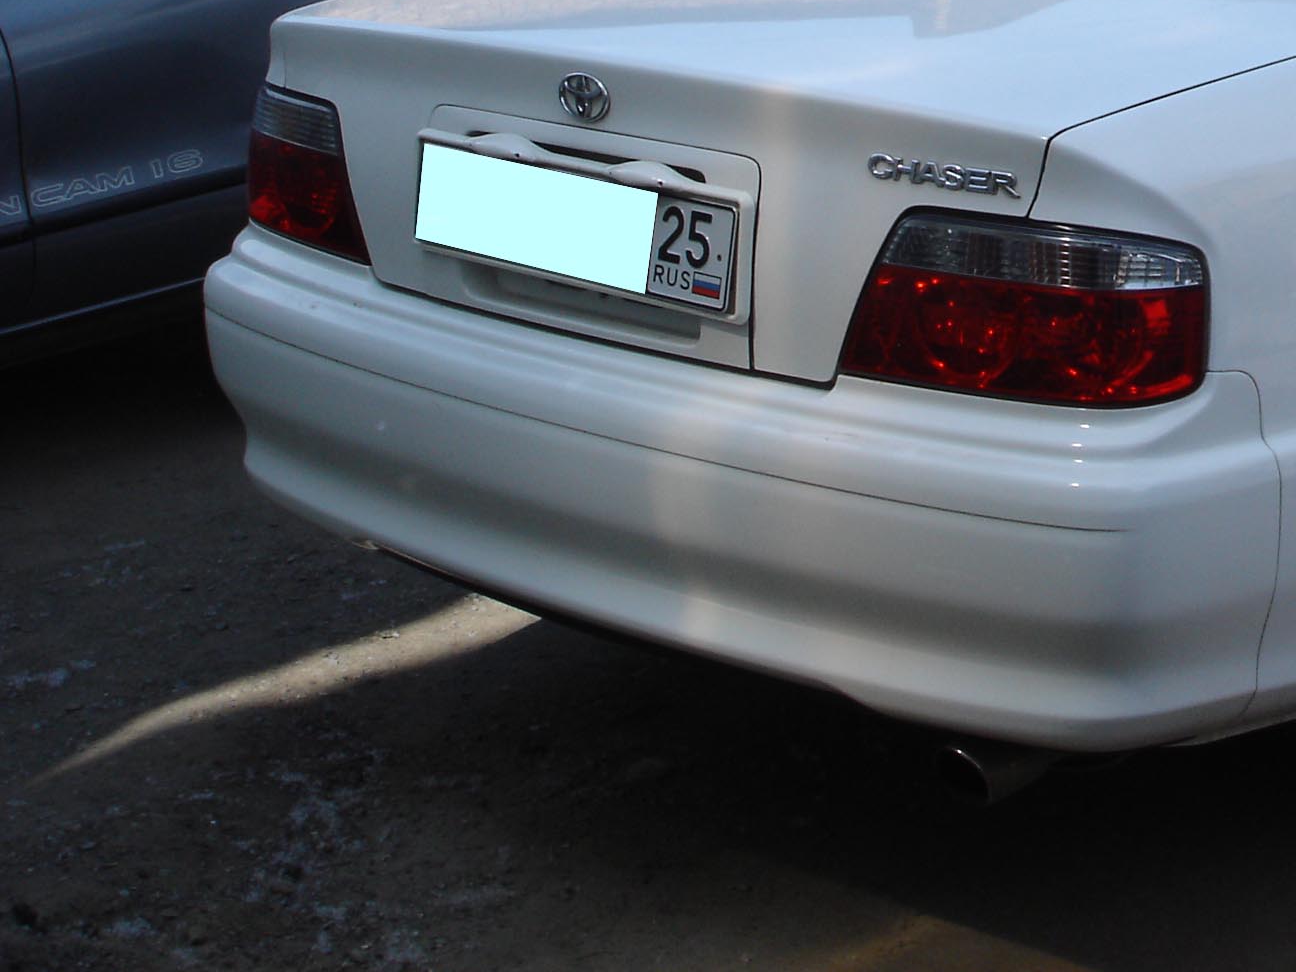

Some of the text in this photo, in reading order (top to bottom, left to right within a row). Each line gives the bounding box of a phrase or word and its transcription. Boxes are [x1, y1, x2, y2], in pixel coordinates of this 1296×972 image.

[31, 166, 136, 208] CAM
[151, 149, 204, 179] 16
[868, 153, 1021, 199] CHASER
[658, 206, 713, 269] 25
[652, 264, 691, 290] RUS
